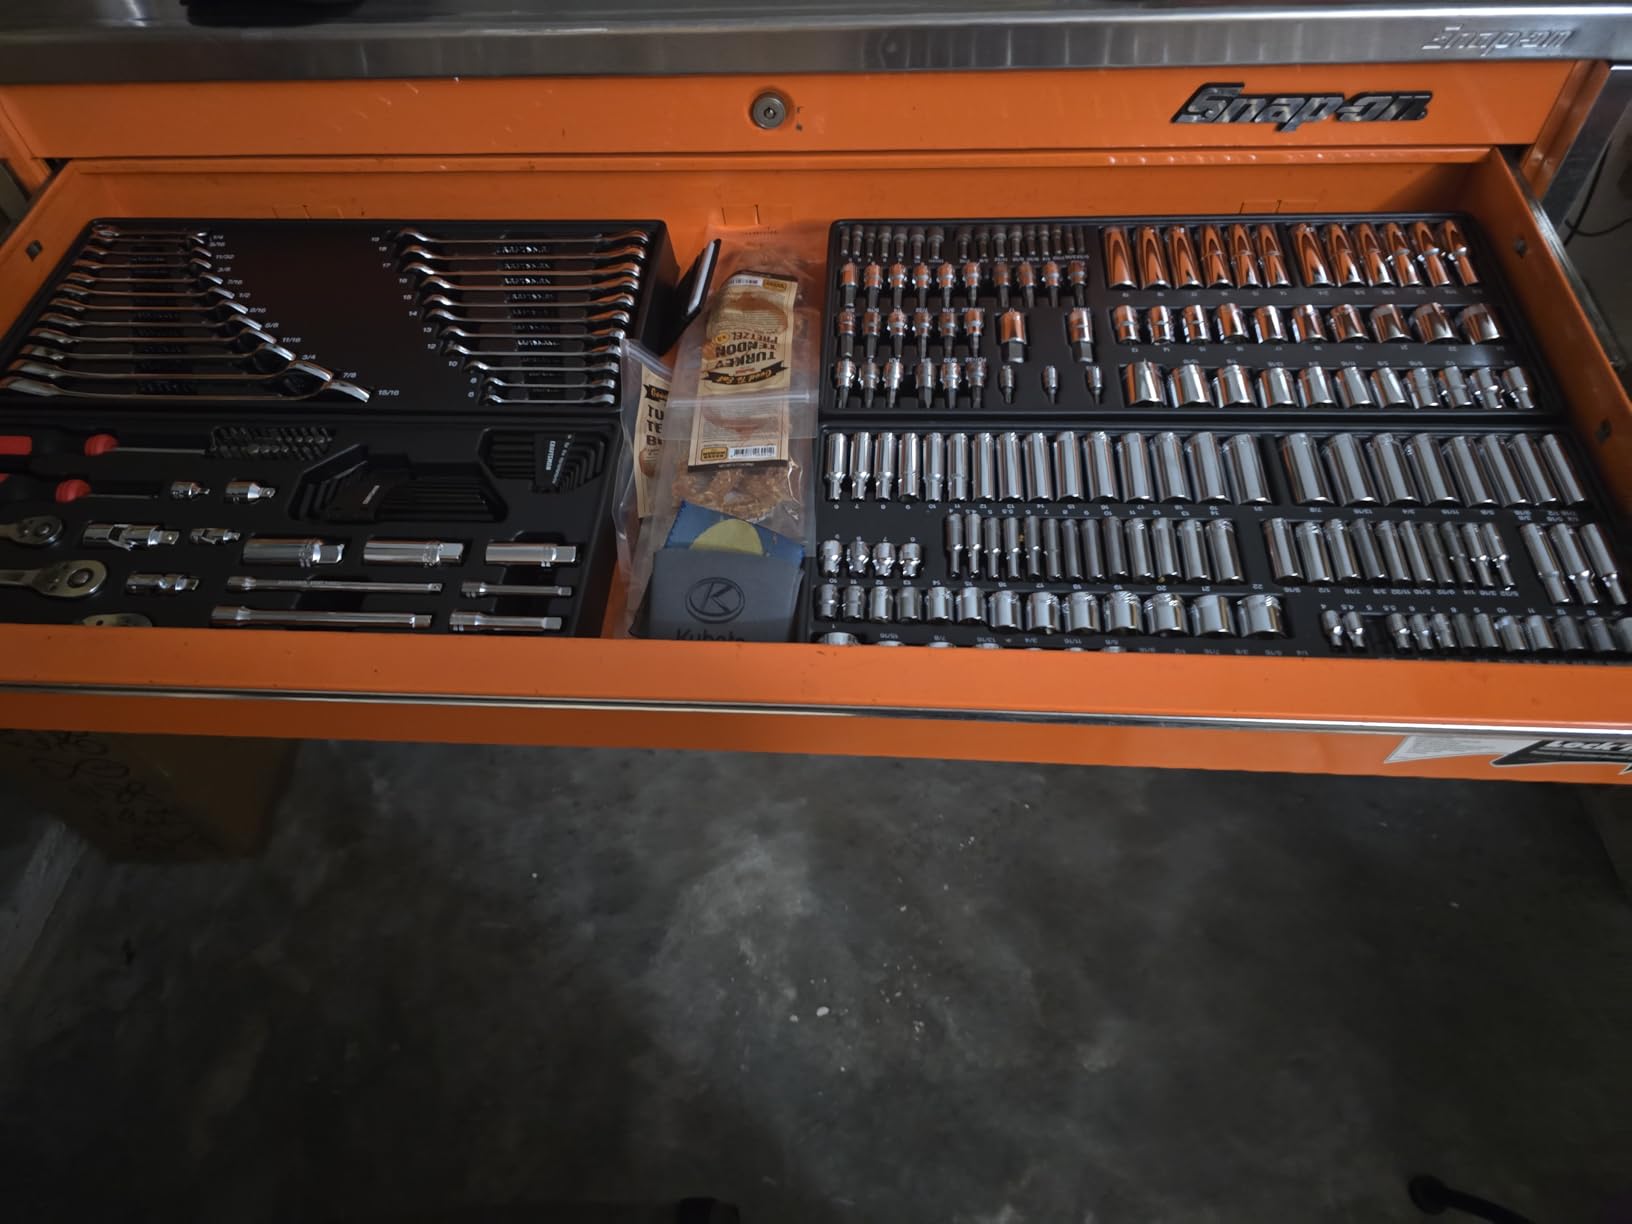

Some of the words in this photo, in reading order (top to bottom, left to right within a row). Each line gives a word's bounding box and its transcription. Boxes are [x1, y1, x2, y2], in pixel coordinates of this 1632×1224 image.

[1421, 24, 1577, 57] Snap-on
[1171, 82, 1433, 132] Snap-on
[732, 332, 778, 344] PRETZEL
[716, 340, 776, 358] TENDON
[714, 352, 776, 369] TURKEY
